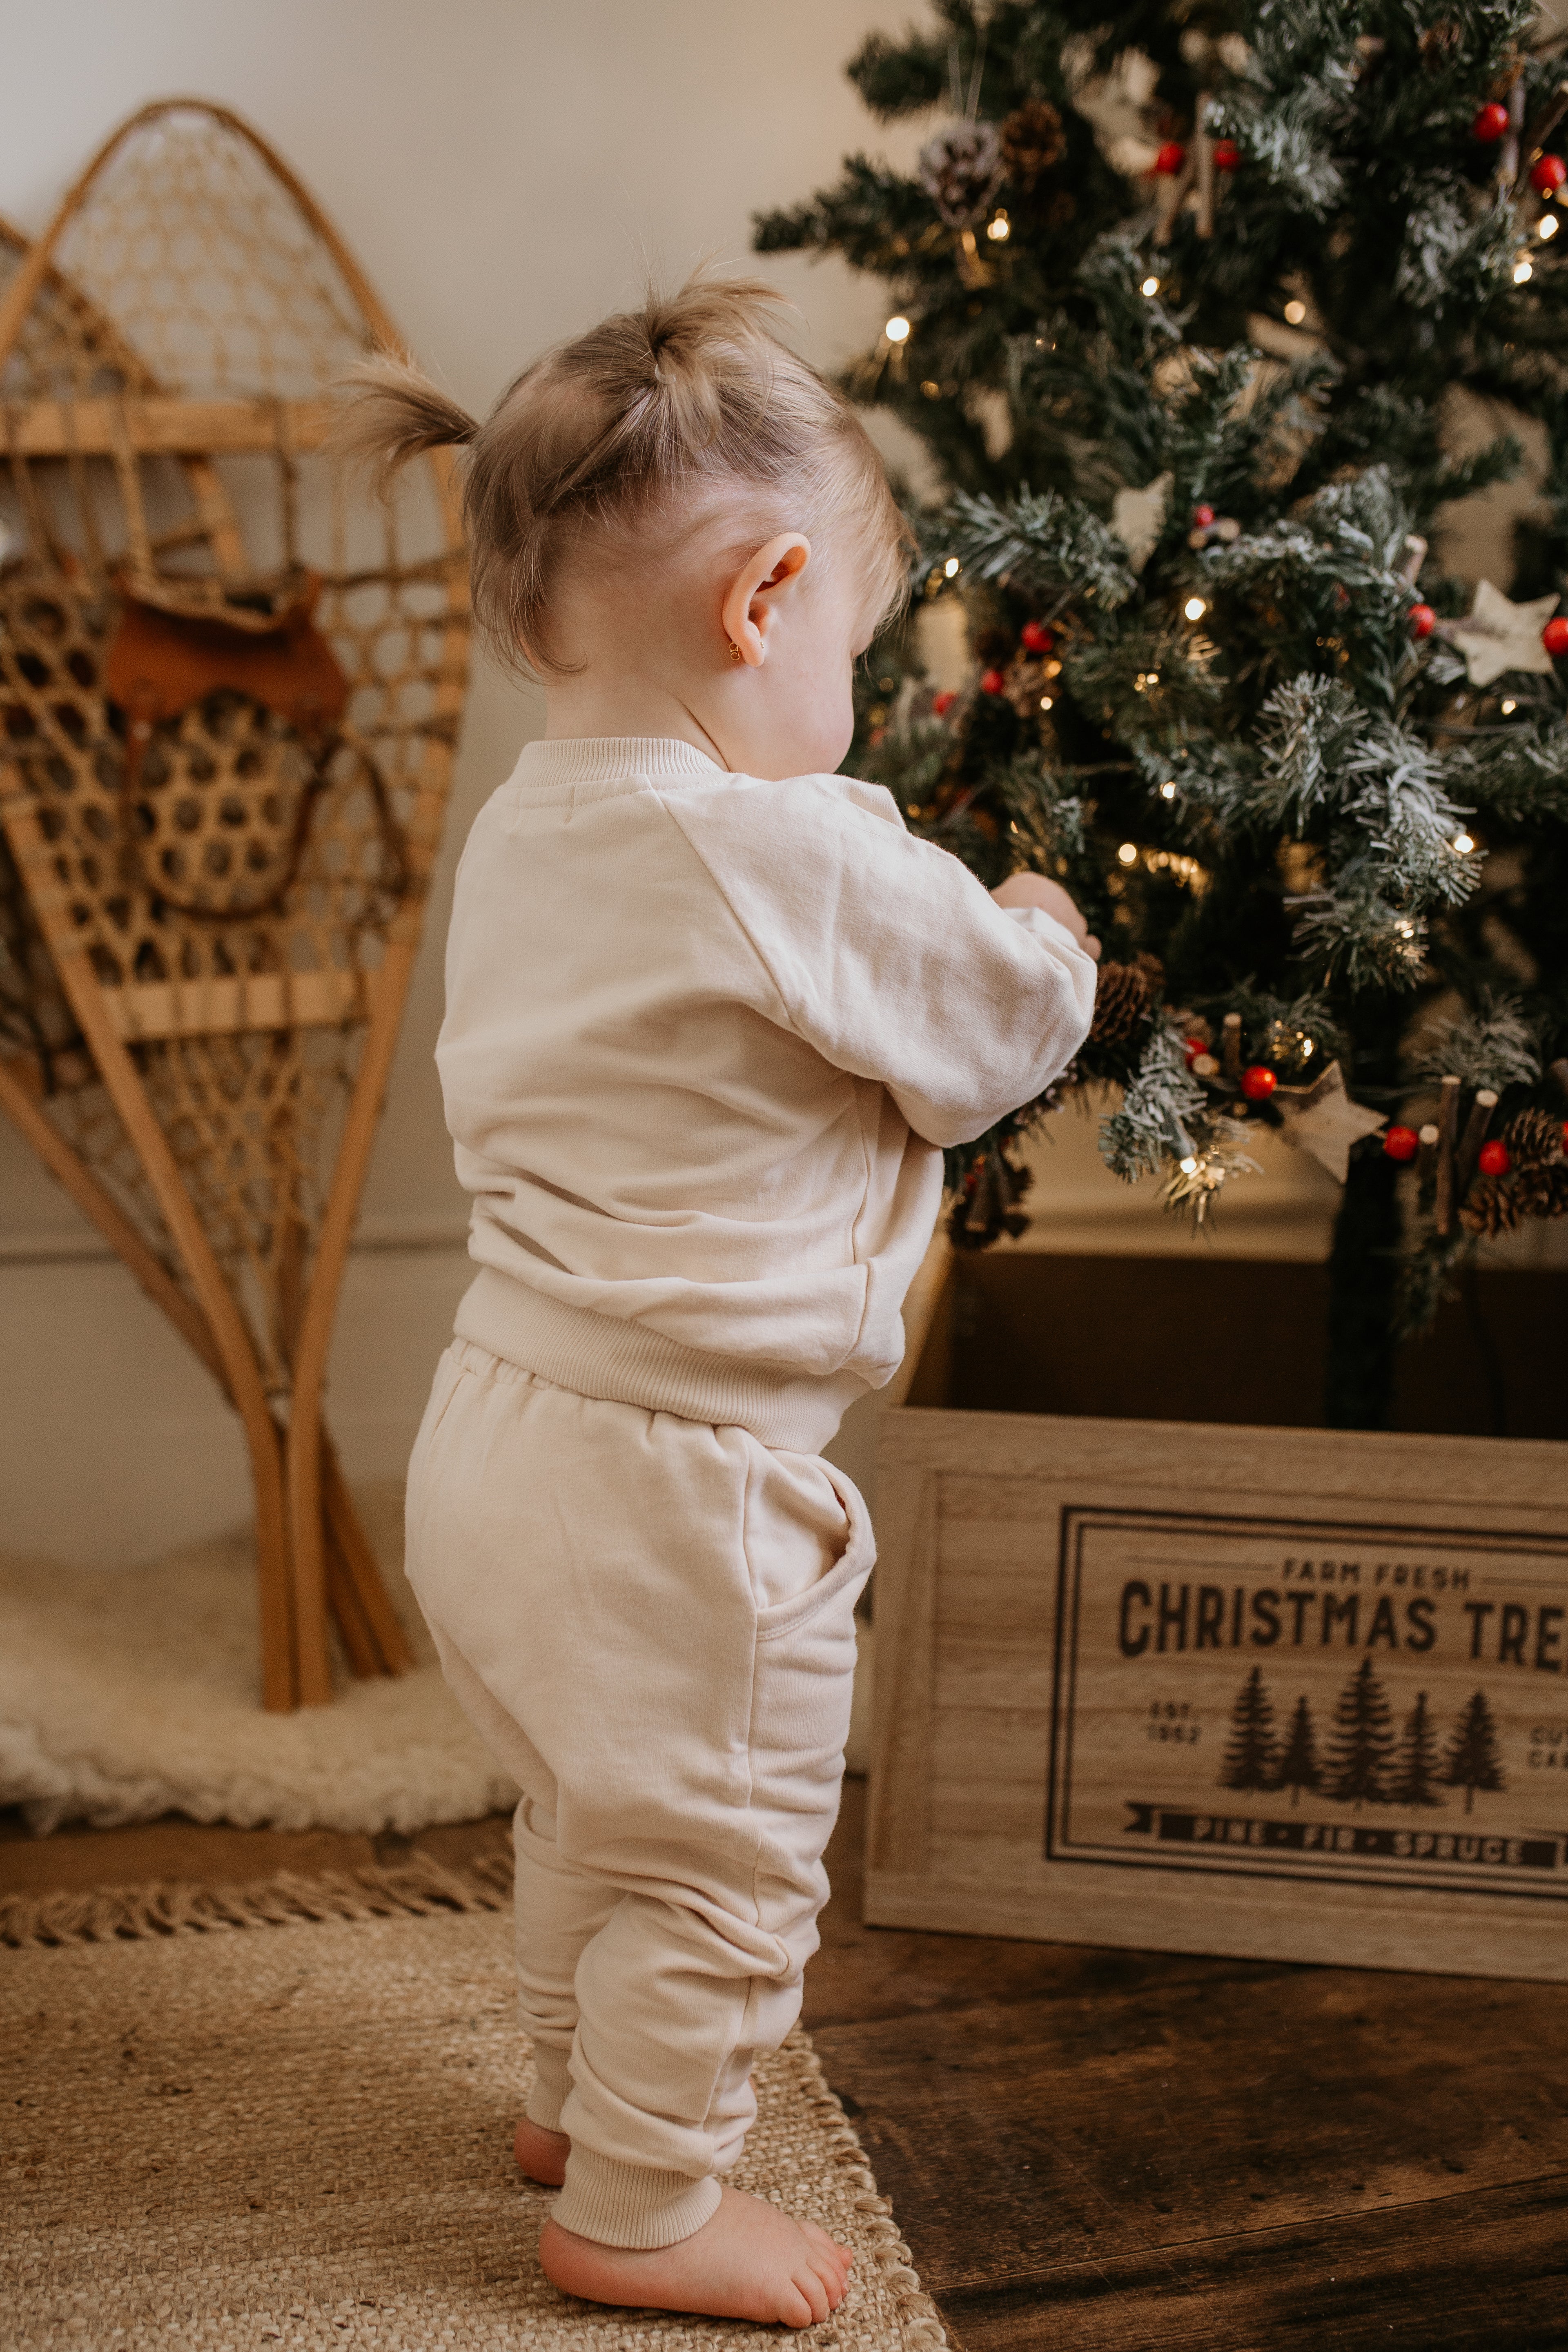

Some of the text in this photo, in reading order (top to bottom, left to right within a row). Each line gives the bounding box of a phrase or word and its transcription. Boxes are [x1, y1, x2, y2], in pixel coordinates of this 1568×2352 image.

[1283, 1557, 1469, 1591] FARM FRESH
[1119, 1579, 1568, 1673] CHRISTMAS TRE
[1530, 1725, 1568, 1747] CU
[1193, 1817, 1522, 1864] PINE FIR SPRUCE
